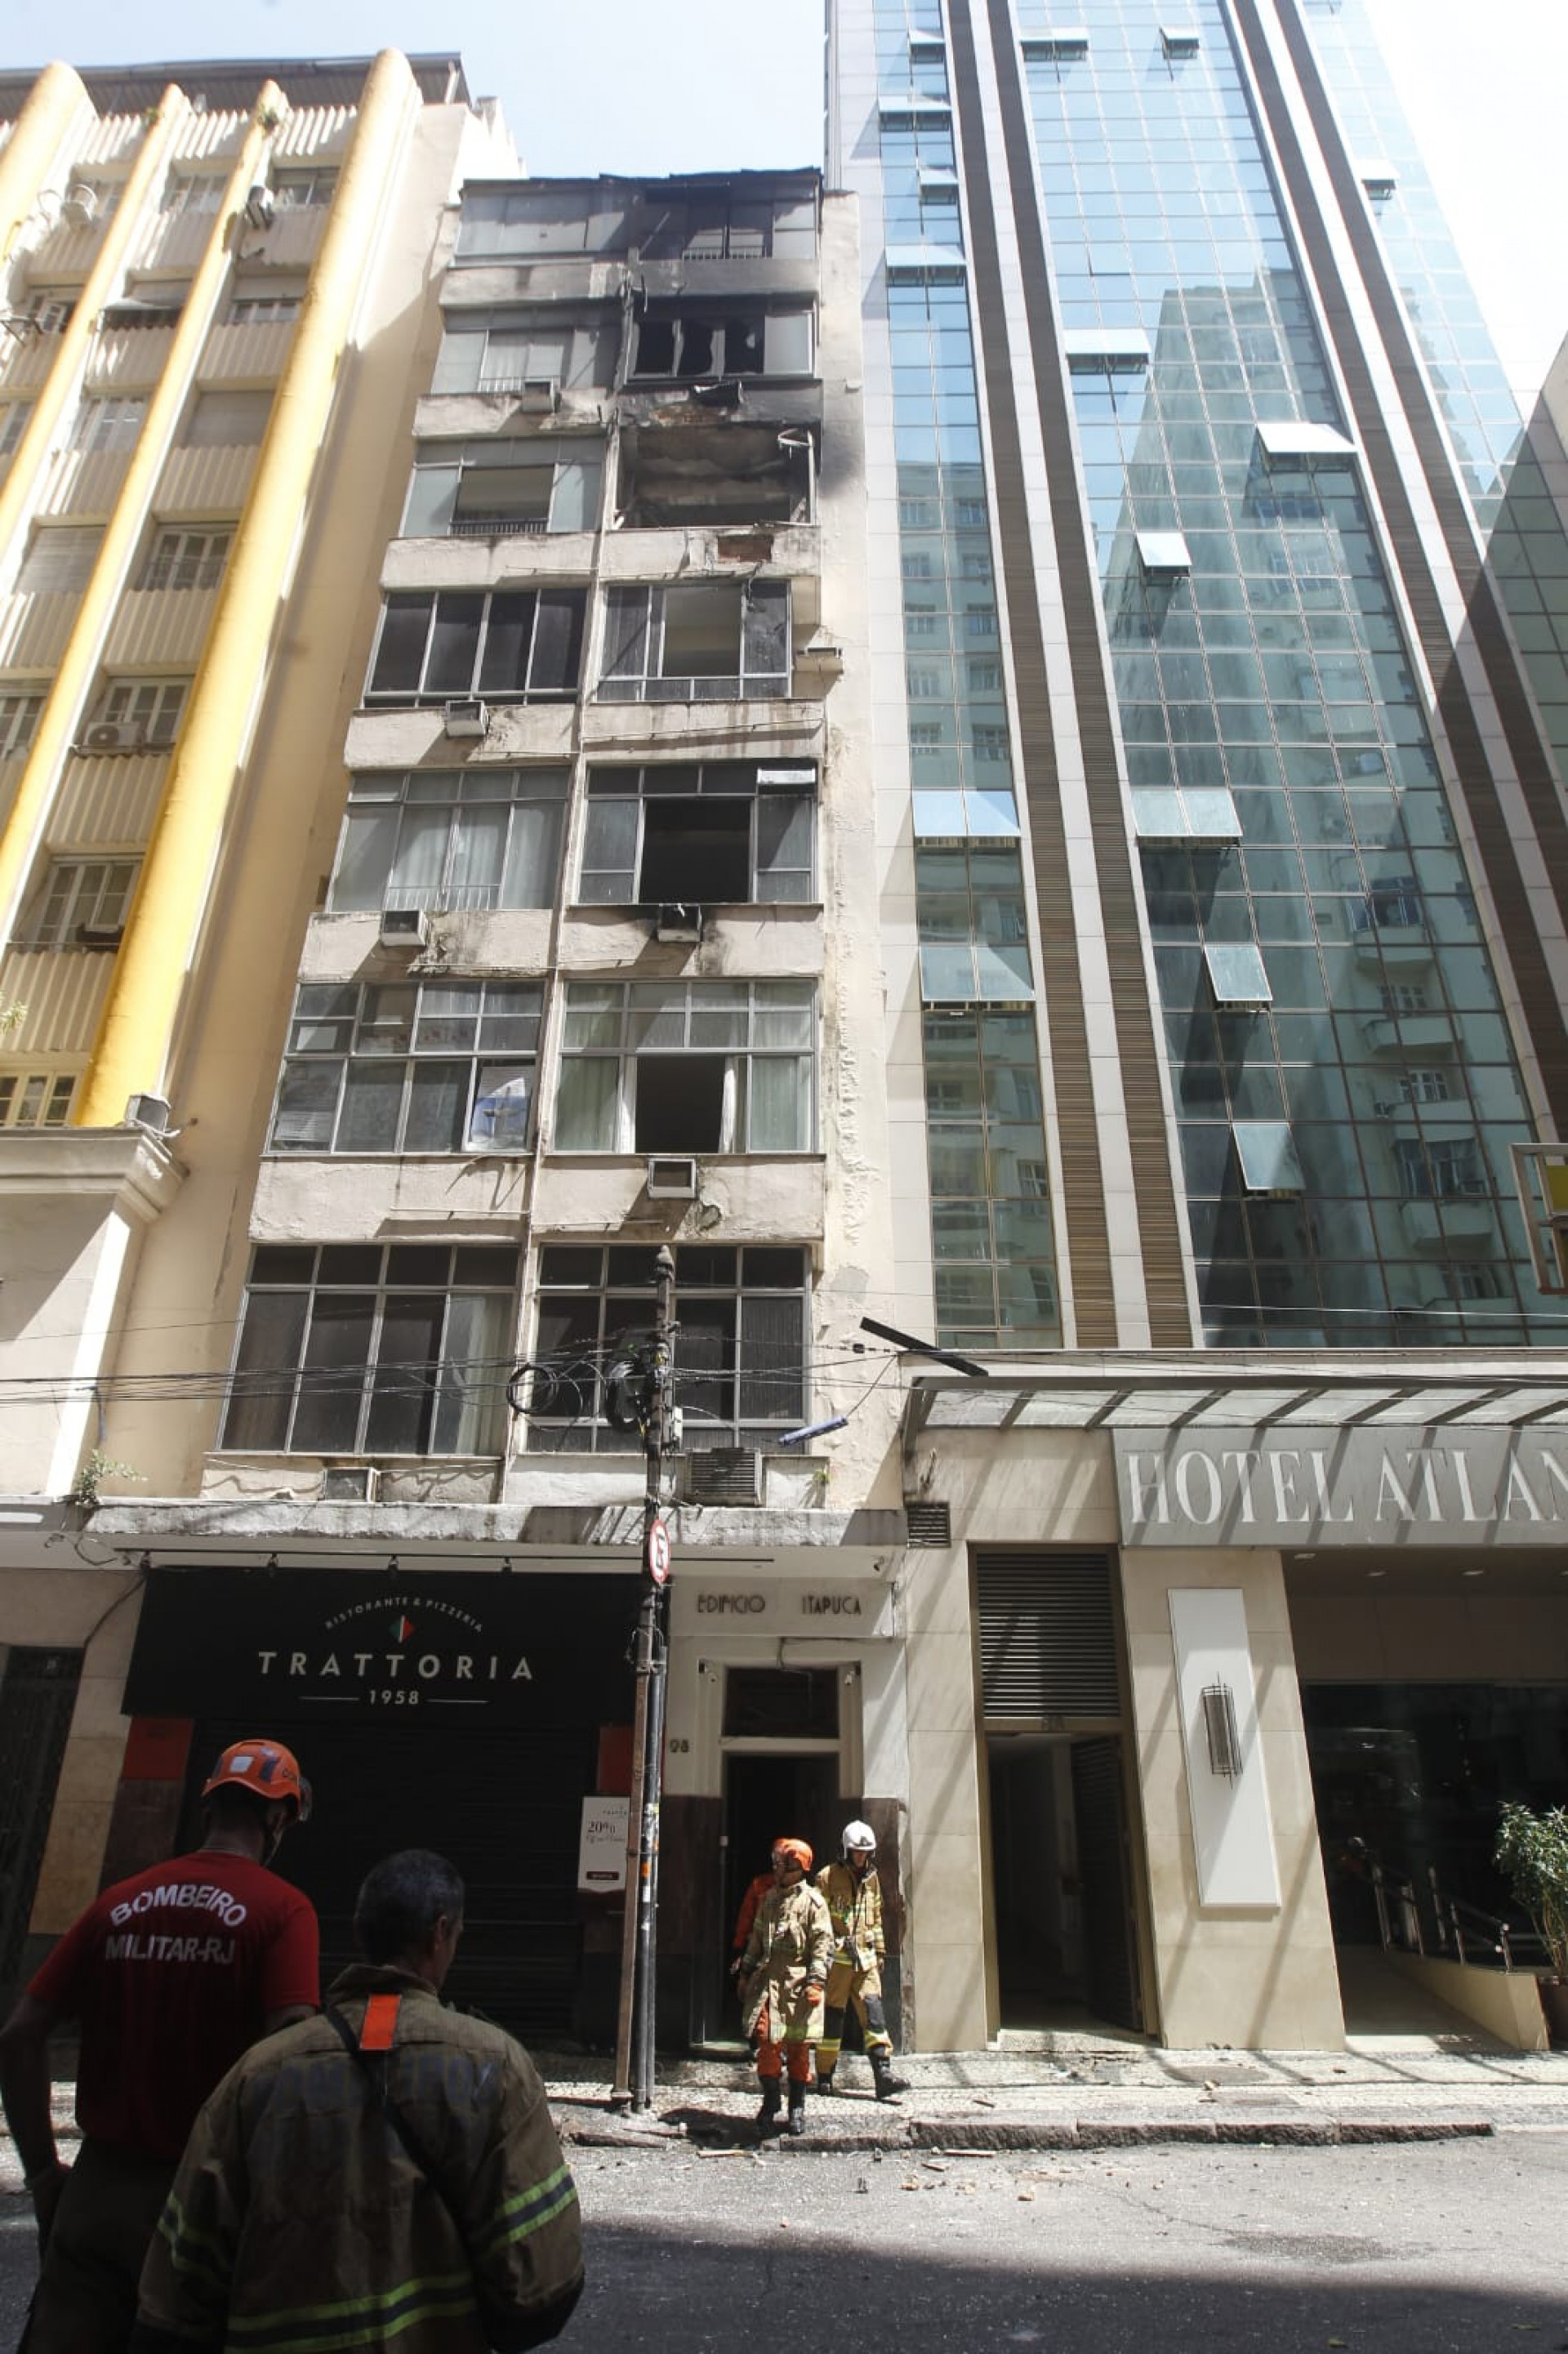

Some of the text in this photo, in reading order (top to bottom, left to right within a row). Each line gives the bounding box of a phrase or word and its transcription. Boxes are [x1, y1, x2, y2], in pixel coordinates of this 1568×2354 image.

[1123, 1447, 1354, 1524] HOTEL
[425, 1599, 483, 1633] PIZZERIA
[801, 1595, 862, 1615] ITAPUCA
[258, 1652, 533, 1679] TRATTORIA
[369, 1690, 420, 1705] 1958
[109, 1884, 247, 1927] BOMBEIRO
[105, 1933, 235, 1964] MILITAR-RJ
